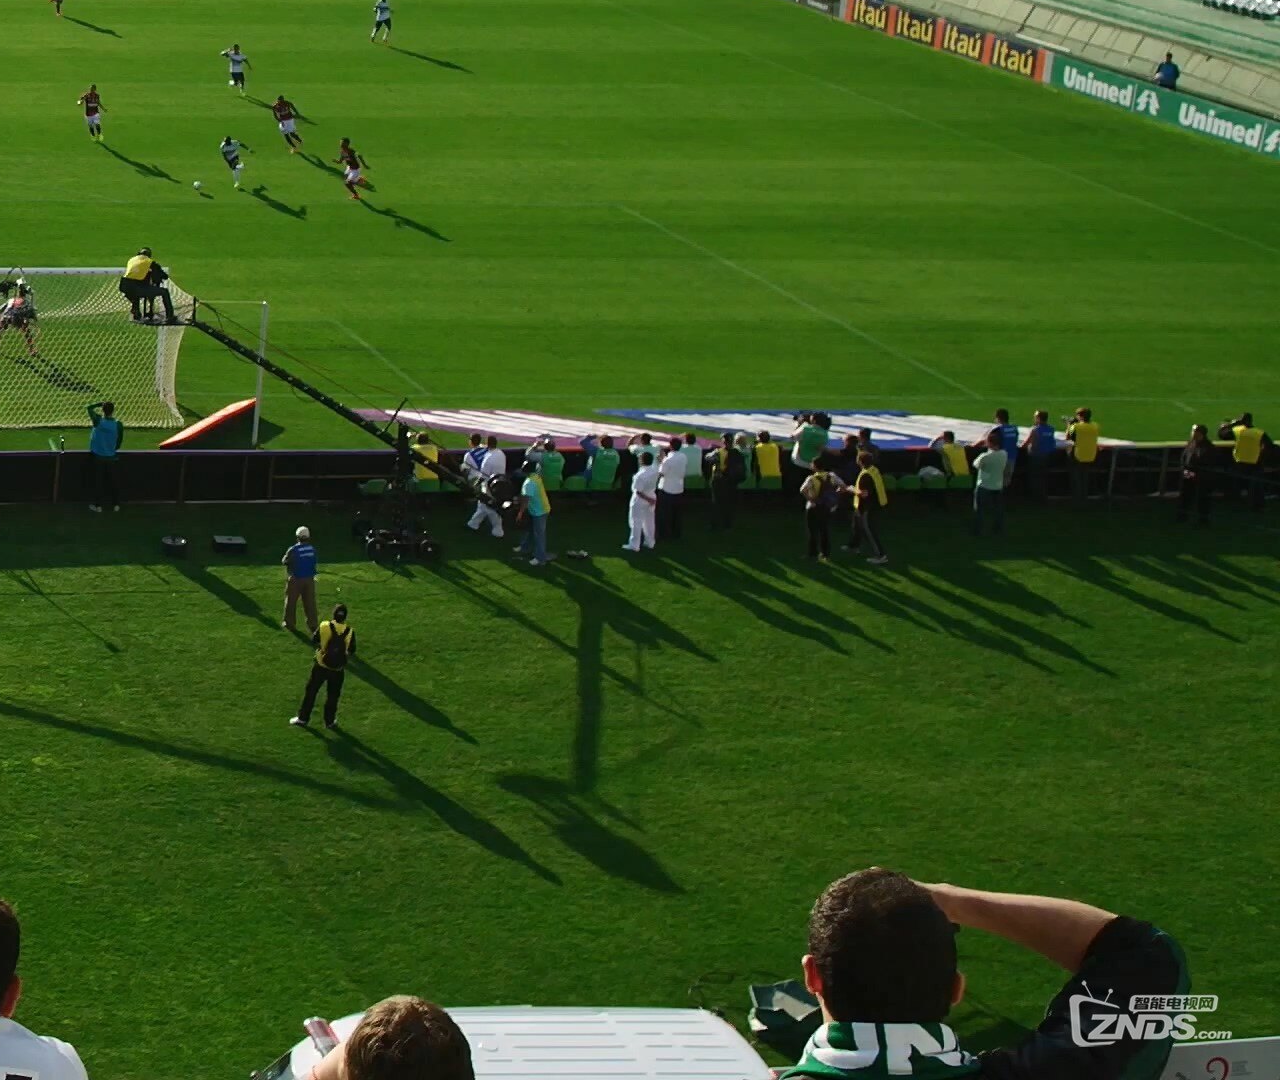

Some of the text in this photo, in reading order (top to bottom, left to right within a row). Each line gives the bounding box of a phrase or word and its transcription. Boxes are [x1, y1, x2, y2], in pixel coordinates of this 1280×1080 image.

[897, 9, 934, 43] Itaú
[943, 22, 983, 60] Itaú
[992, 38, 1034, 76] Itaú
[1063, 65, 1133, 107] Unimed
[1178, 102, 1262, 148] Unimed
